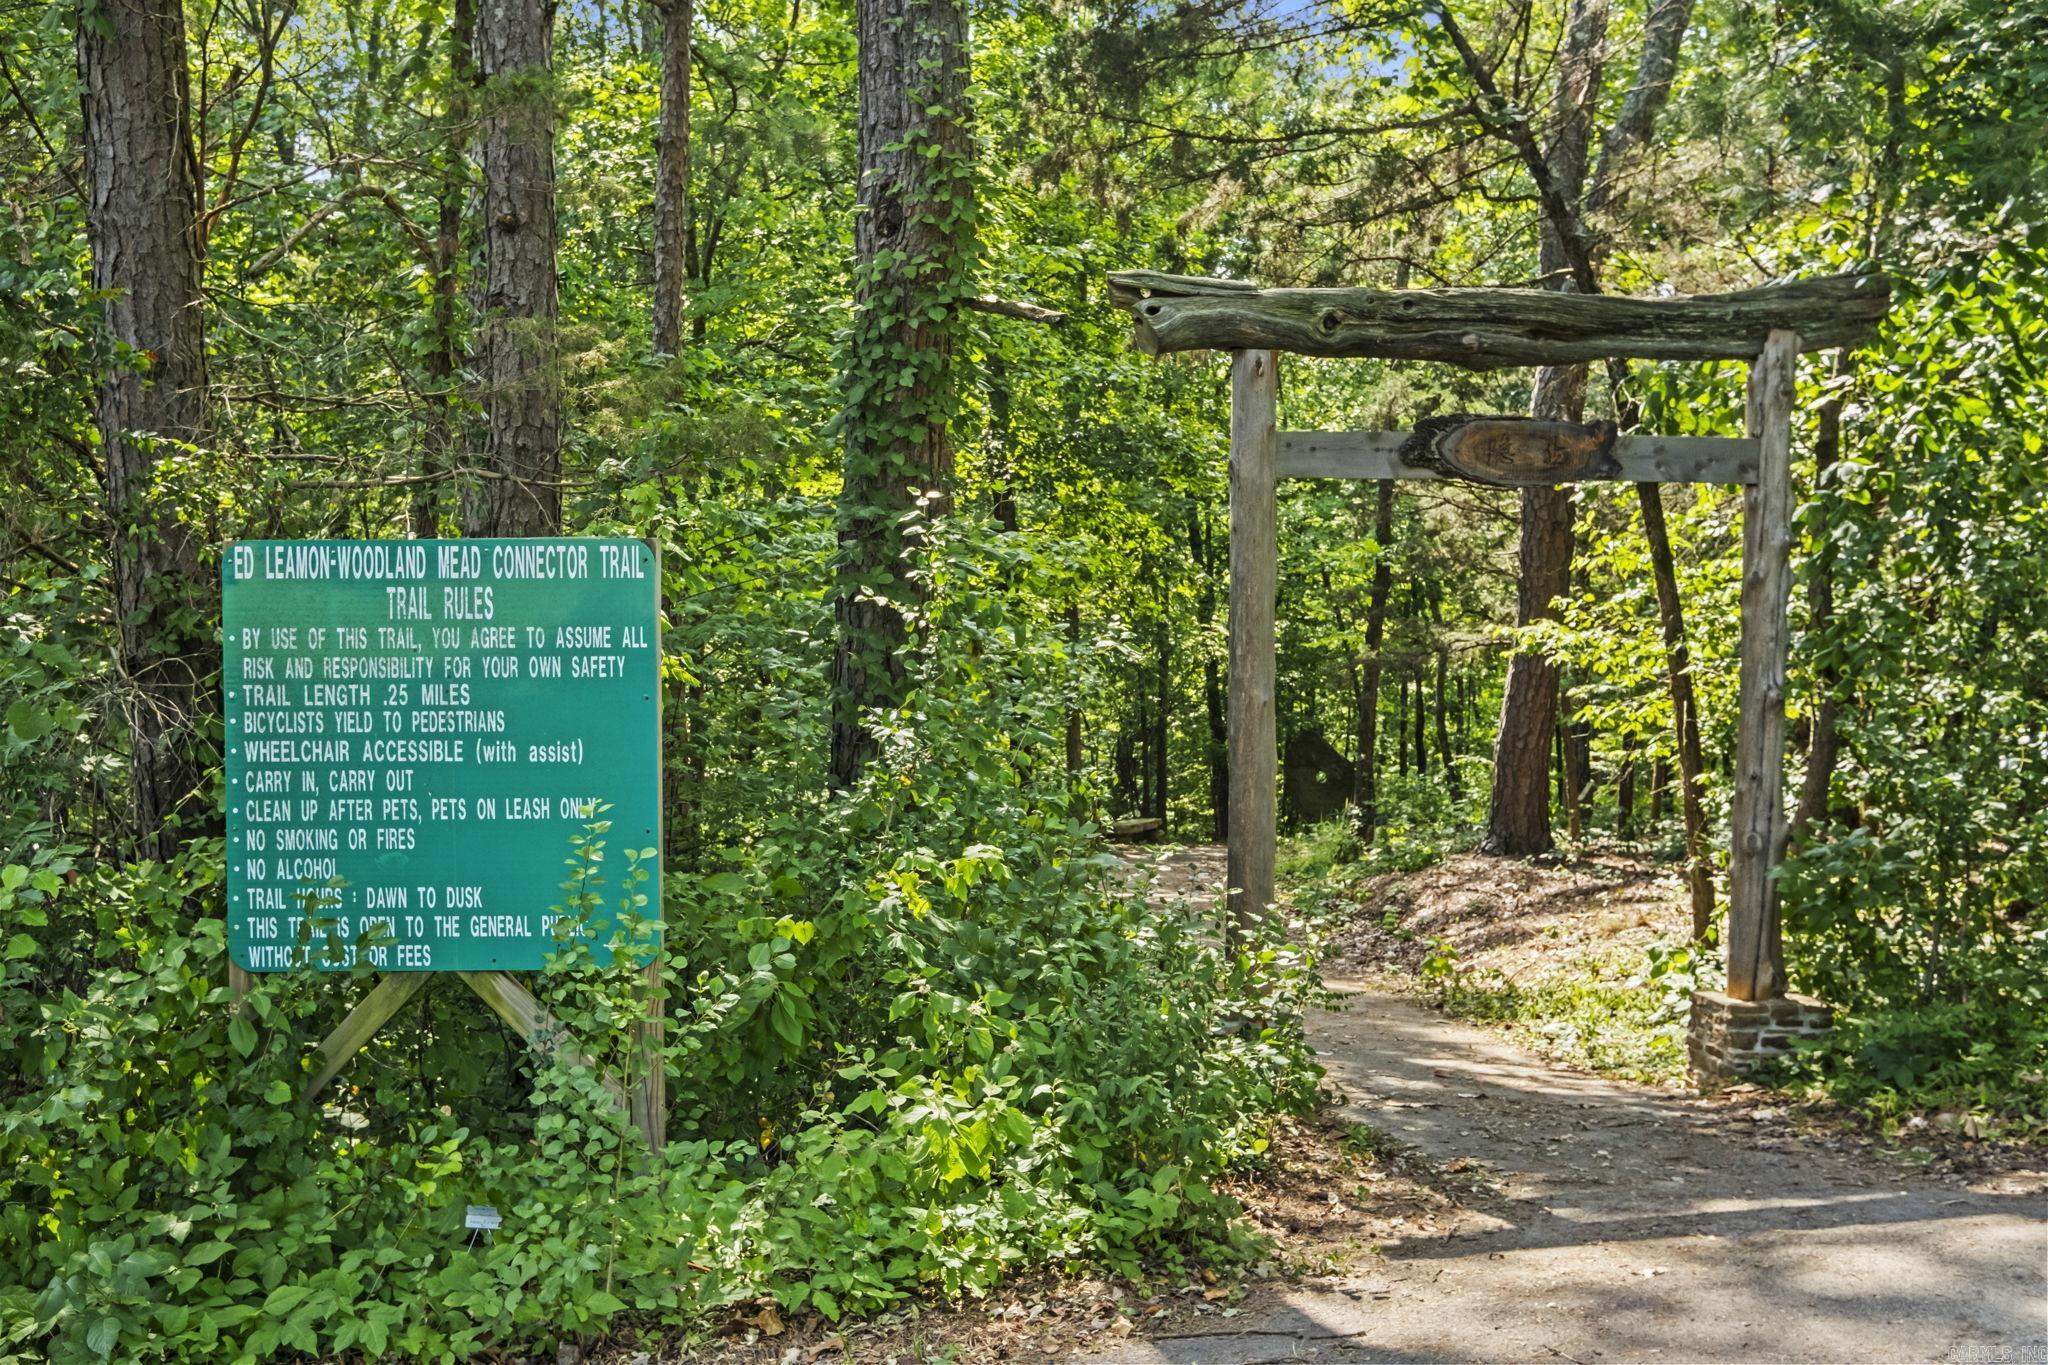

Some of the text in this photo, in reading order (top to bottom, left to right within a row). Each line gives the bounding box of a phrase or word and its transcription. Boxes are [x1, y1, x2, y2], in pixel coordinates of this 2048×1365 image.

[234, 544, 645, 580] ED LEAMON-WOODLAND MEAD CONNECTOR TRAIL
[386, 585, 494, 620] TRAIL RULES
[242, 626, 648, 654] BY USE OF THIS TRAIL, YOU AGREE TO ASSUME ALL
[243, 655, 625, 679] RISK AND RESPONSIBILITY FOR YOUR OWN SAFETY
[242, 683, 471, 707] TRAIL LENGTH .25 MILES
[243, 710, 505, 734] BICYCLISTS YIELD TO PEDESTRIANS
[243, 737, 583, 765] WHEELCHAIR ACCESSIBLE (with assist)
[245, 769, 414, 796] CARRY IN, CARRY OUT
[245, 797, 597, 825] CLEAN UP AFTER PETS, PETS ON LEASH ONLY
[246, 827, 416, 852] NO SMOKING OR FIRES
[247, 858, 266, 881] NO
[246, 887, 287, 910] TRAIL
[366, 886, 408, 909] DAWN
[417, 886, 437, 909] TO
[446, 886, 483, 909] DUSK
[246, 916, 278, 939] THIS
[336, 915, 350, 940] IS
[405, 915, 424, 938] TO
[433, 915, 461, 938] THE
[470, 915, 532, 938] GENERAL
[248, 944, 312, 968] WITHOT
[368, 946, 388, 966] OR
[397, 944, 431, 967] FEES
